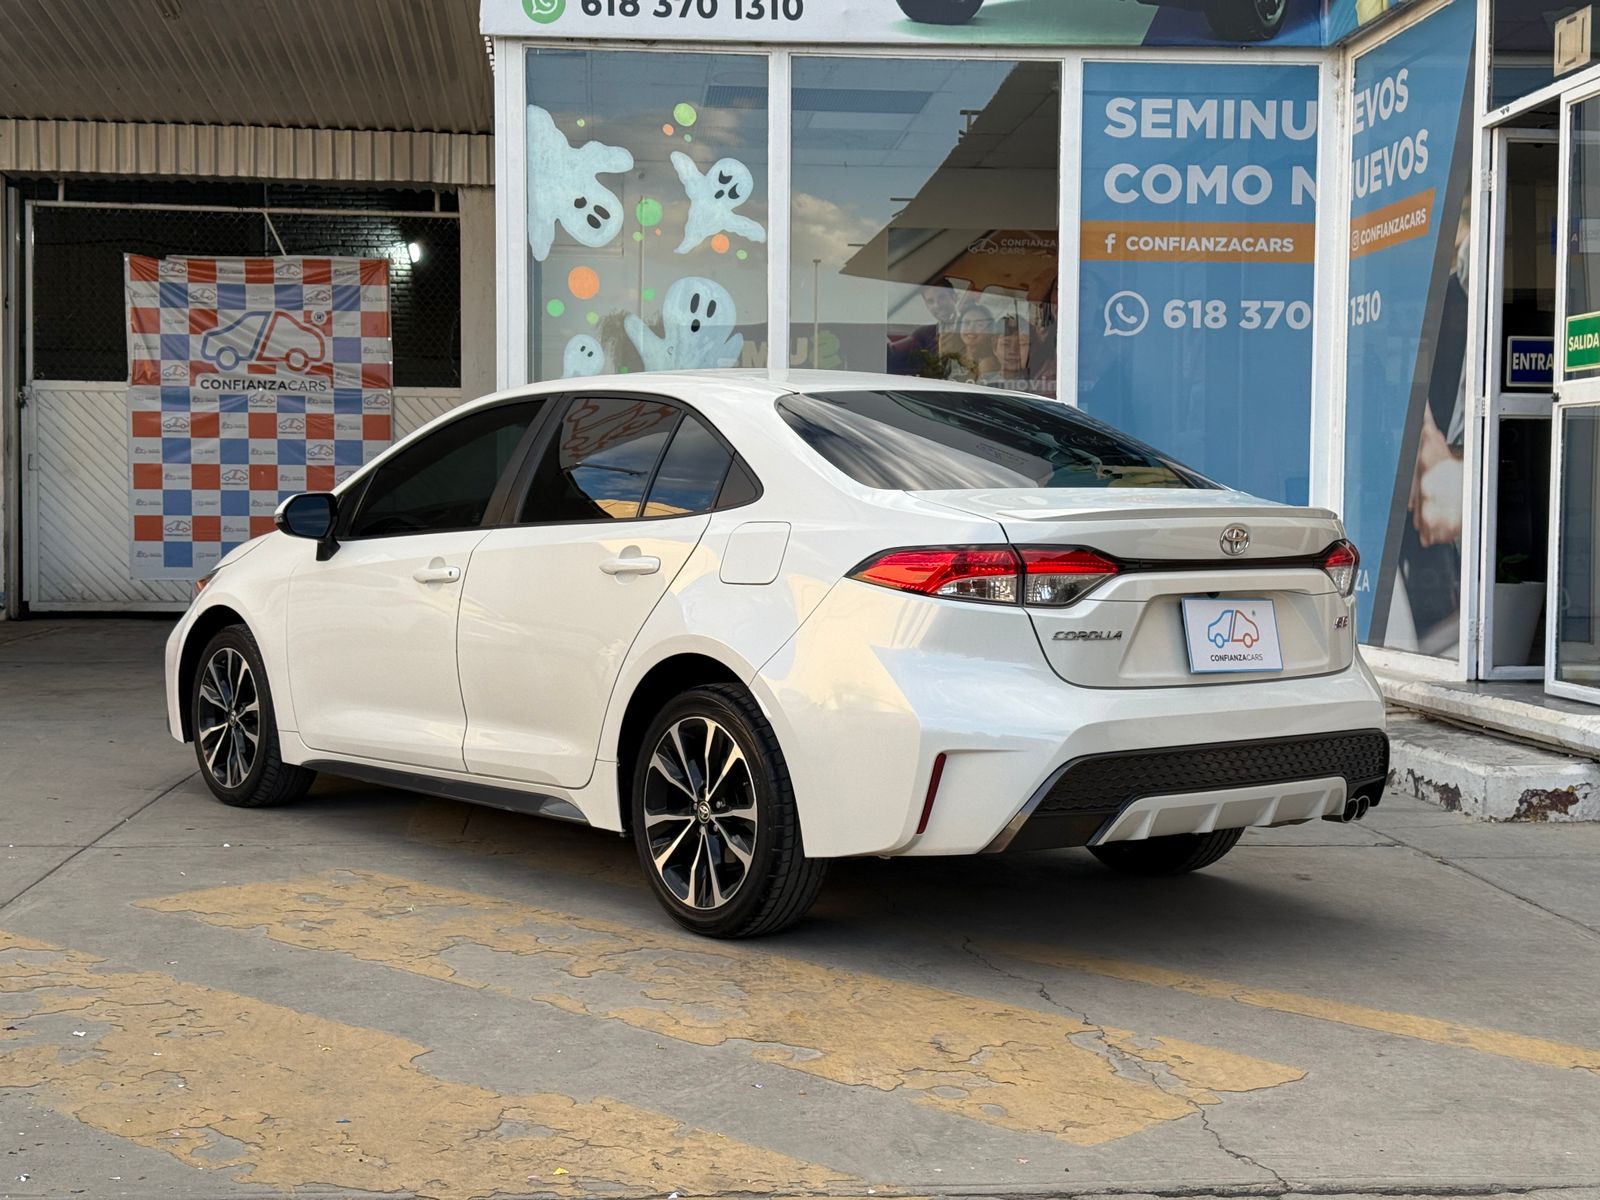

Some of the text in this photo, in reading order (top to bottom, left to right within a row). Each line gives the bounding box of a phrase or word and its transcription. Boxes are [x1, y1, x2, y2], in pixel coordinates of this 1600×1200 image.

[581, 0, 804, 21] 618 370 1310
[1353, 67, 1409, 136] EVOS
[1103, 97, 1317, 141] SEMINU
[1351, 128, 1429, 201] UEVOS
[1103, 163, 1273, 206] COMO
[1360, 208, 1427, 246] CONFIANZACARS
[1000, 238, 1056, 247] CONFIANZA
[1126, 235, 1295, 253] CONFIANZACARS
[1163, 299, 1312, 330] 618 370
[1350, 290, 1381, 327] 1310
[1568, 332, 1600, 352] SALIDA
[200, 379, 327, 393] CONFIANZACARS
[1051, 630, 1124, 641] COROLLA
[1210, 653, 1264, 663] CONFIANZACARS
